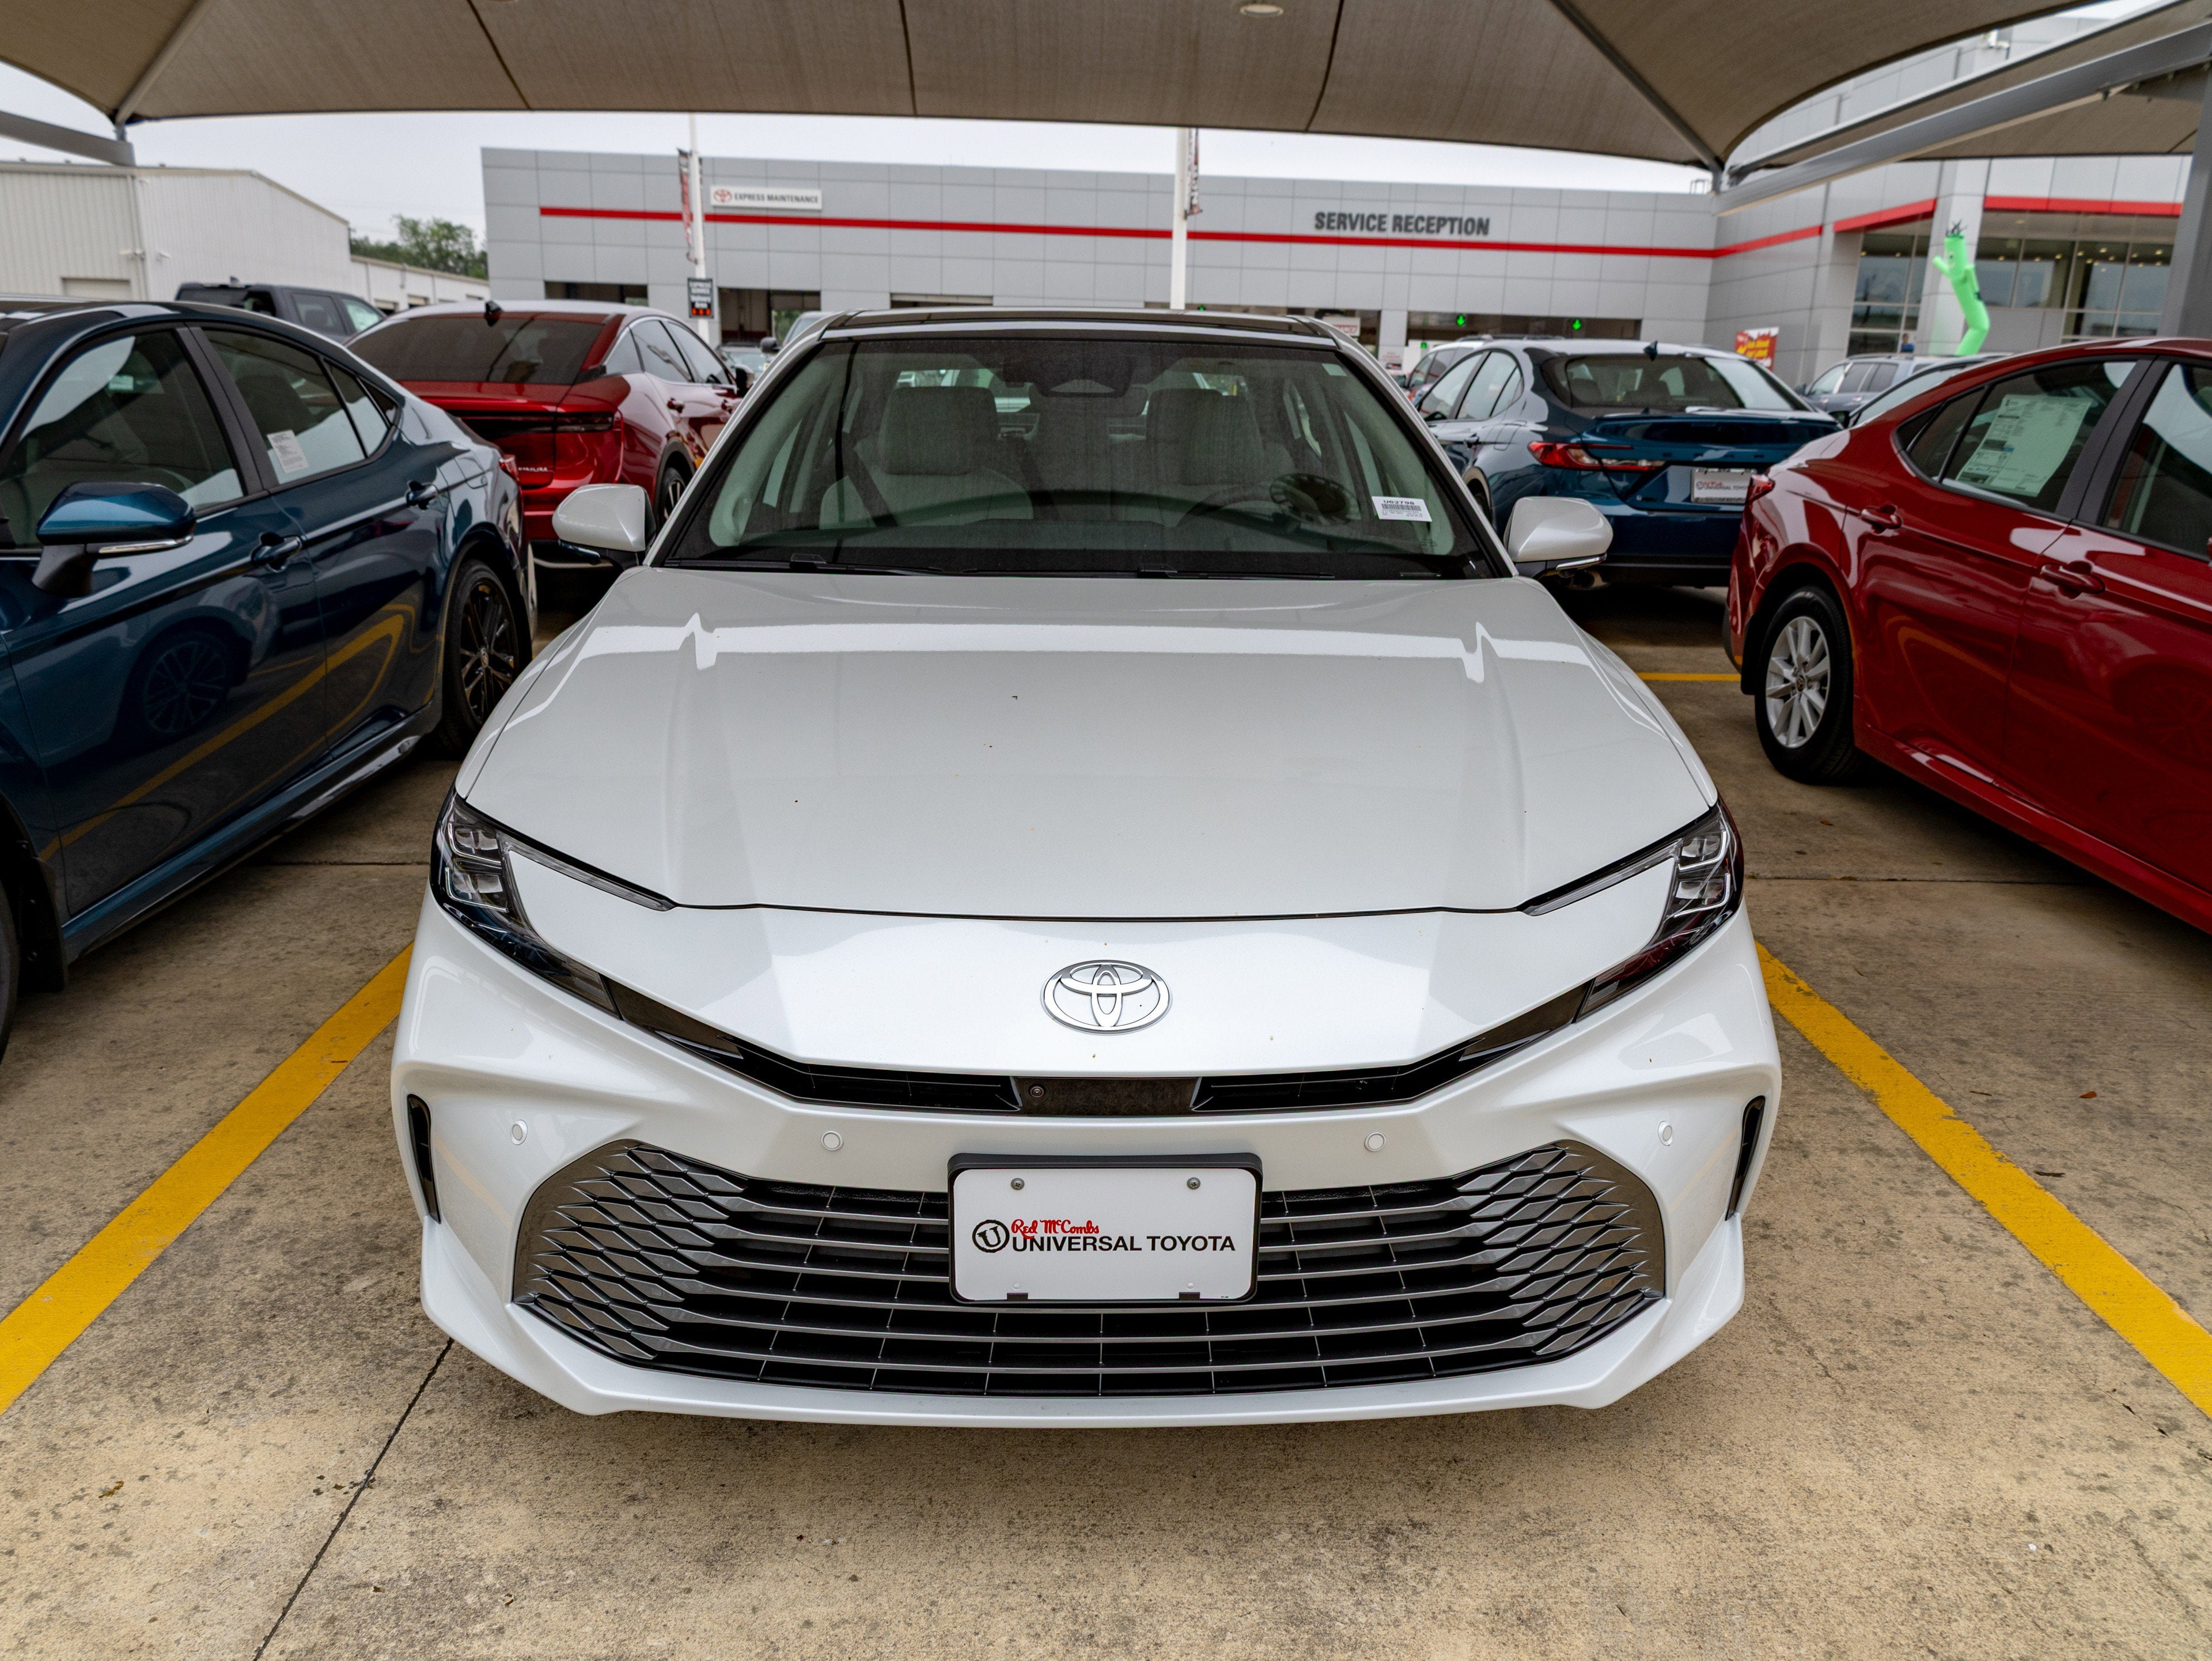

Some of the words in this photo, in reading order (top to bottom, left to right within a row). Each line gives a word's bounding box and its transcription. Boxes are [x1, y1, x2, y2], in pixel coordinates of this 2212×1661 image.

[734, 192, 765, 202] EXPRESS
[767, 194, 819, 203] MAINTENANCE
[1315, 211, 1387, 232] SERVICE
[1392, 214, 1490, 236] RECEPTION
[1011, 1219, 1038, 1239] Red
[1039, 1219, 1100, 1234] McCombs
[1012, 1235, 1142, 1252] UNIVERSAL
[1146, 1235, 1236, 1251] TOYOTA
